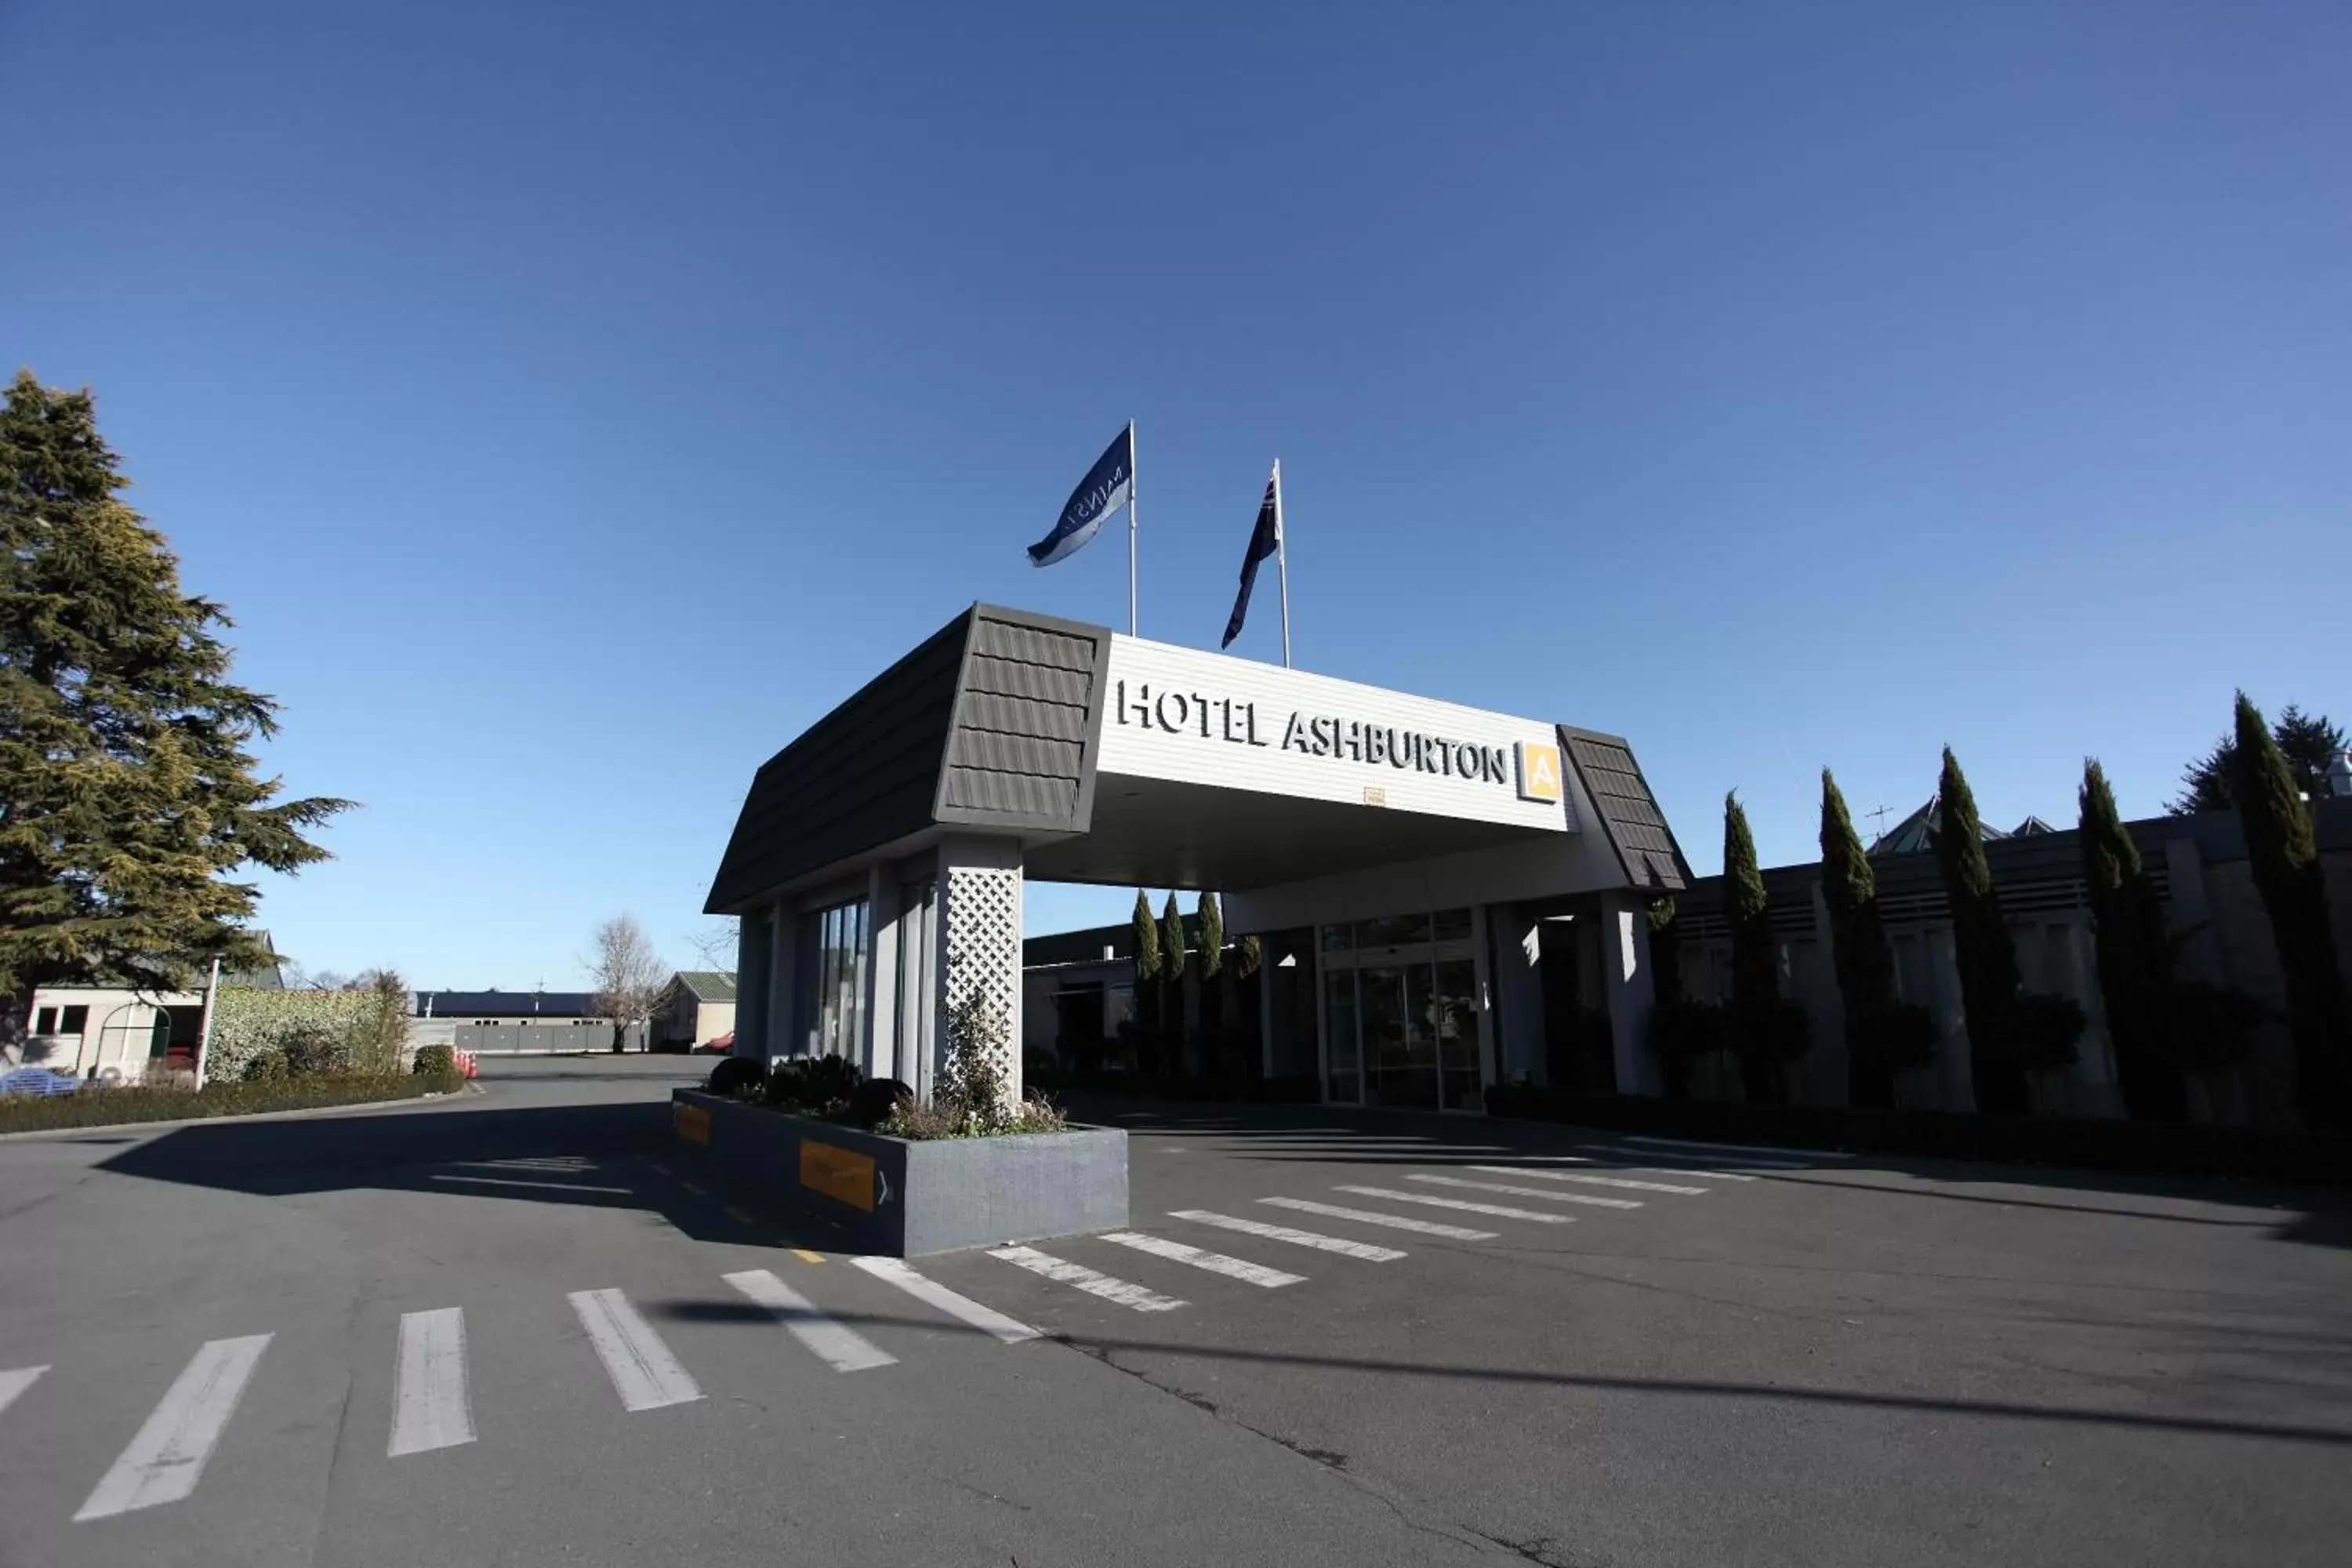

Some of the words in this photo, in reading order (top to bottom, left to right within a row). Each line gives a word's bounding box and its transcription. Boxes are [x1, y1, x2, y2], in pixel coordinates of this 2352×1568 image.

[1117, 679, 1270, 746] HOTEL
[1281, 710, 1507, 784] ASHBURTON
[1531, 753, 1556, 788] A
